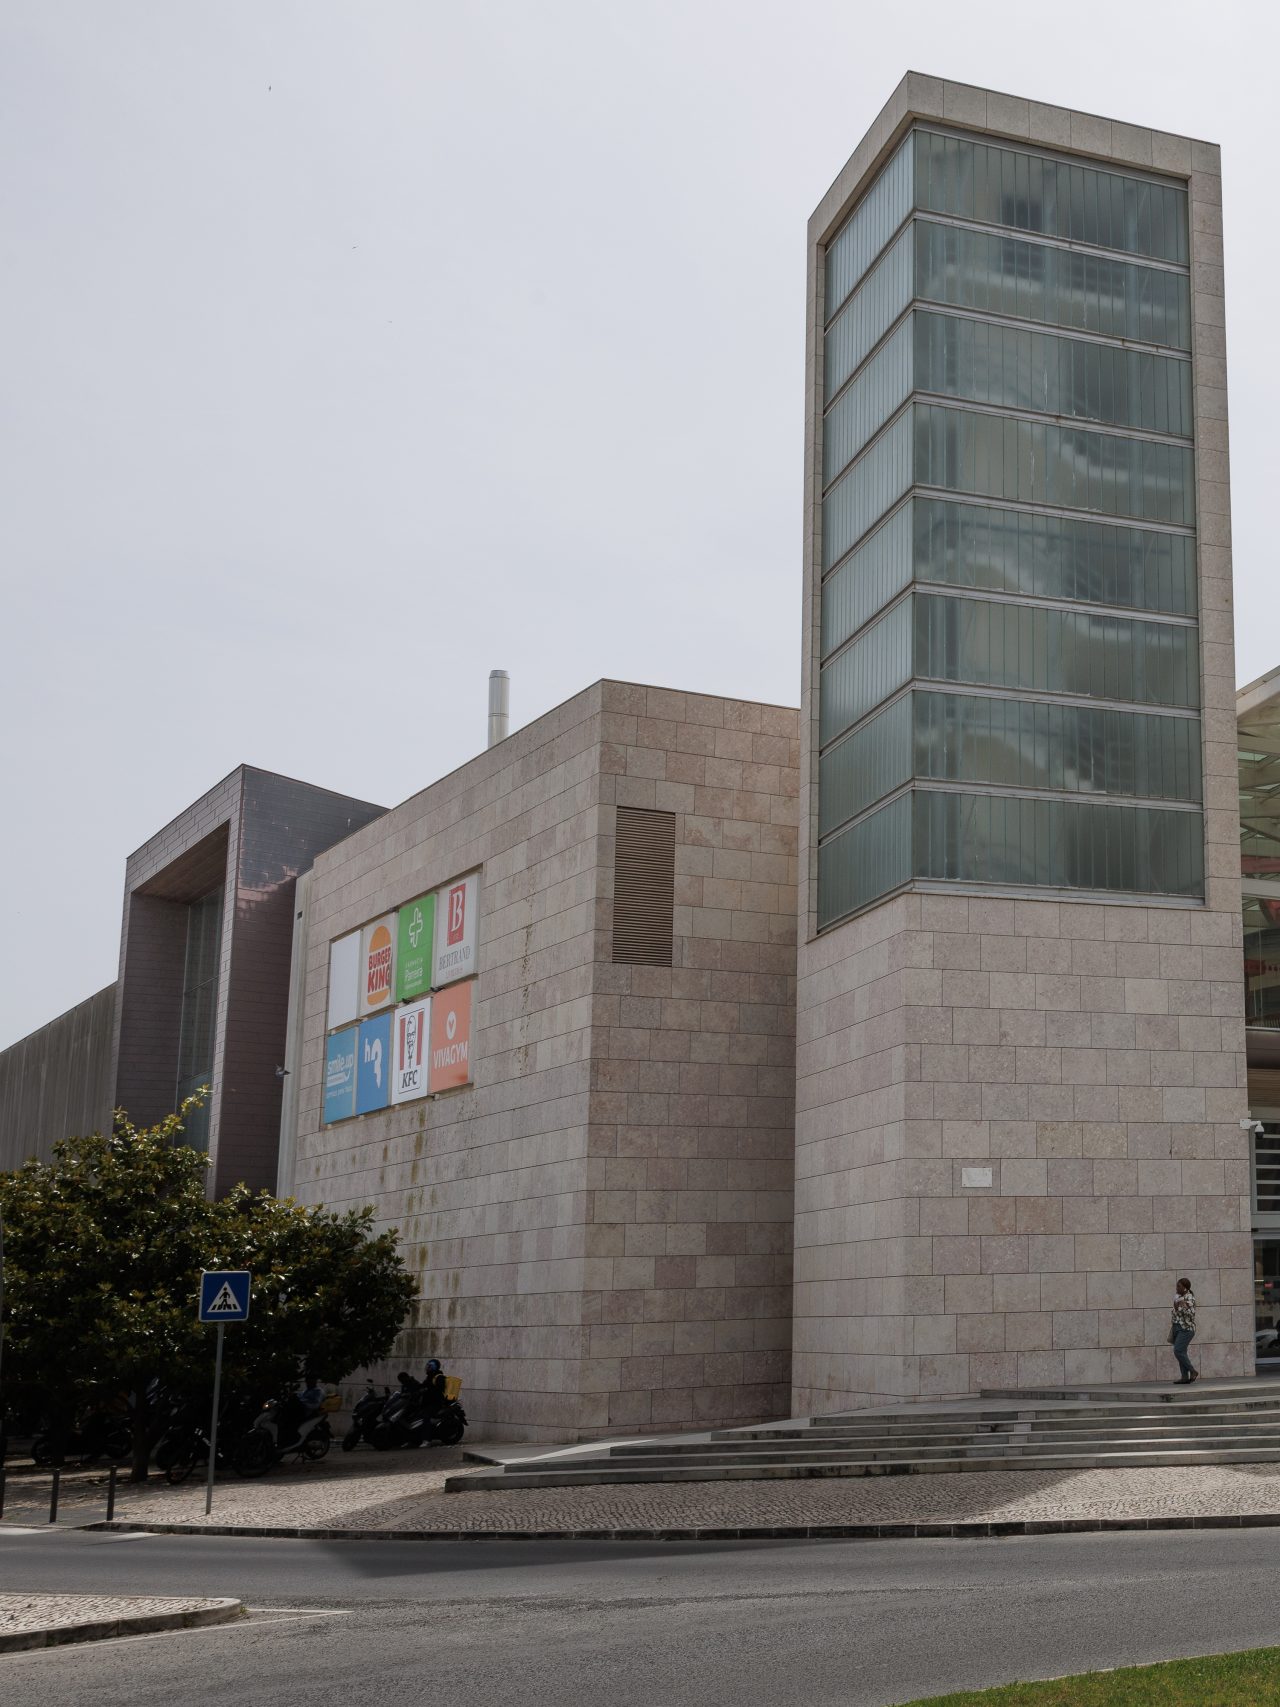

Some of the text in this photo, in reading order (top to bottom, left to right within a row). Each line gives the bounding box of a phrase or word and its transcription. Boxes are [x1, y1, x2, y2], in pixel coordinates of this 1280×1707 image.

[368, 945, 392, 971] BURGER
[439, 945, 471, 971] BERTRAND
[367, 963, 392, 993] KING
[433, 1040, 469, 1070] VIVAGYM
[402, 1070, 418, 1089] KFC
